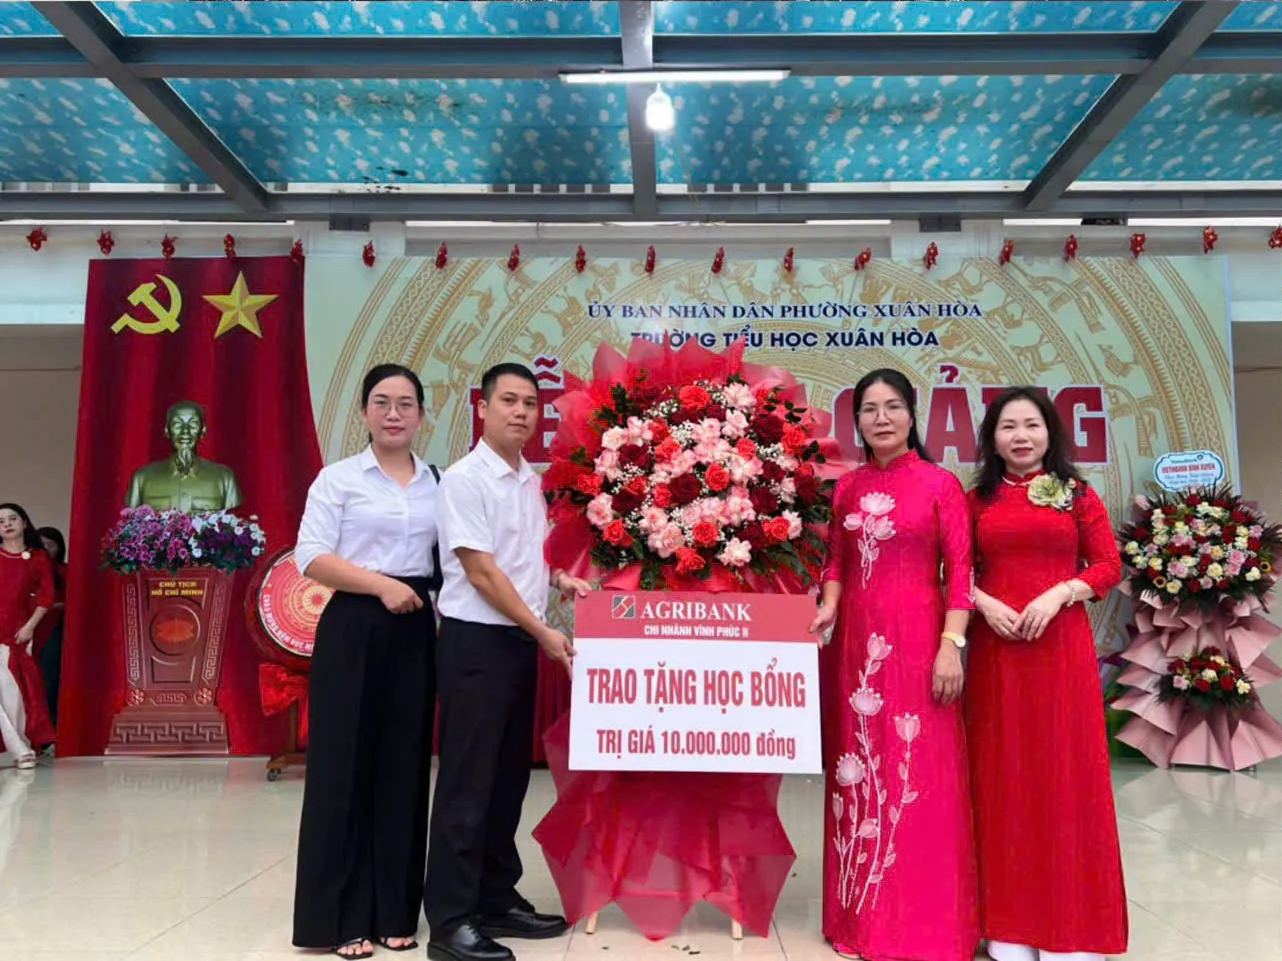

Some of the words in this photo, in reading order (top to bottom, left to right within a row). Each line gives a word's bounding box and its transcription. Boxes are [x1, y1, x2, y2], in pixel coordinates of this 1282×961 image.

[588, 300, 615, 319] ỦY
[622, 305, 662, 318] BAN
[669, 302, 726, 319] NHÂN
[732, 302, 775, 319] DÂN
[781, 300, 867, 319] PHƯỜNG
[874, 301, 932, 318] XUÂN
[937, 299, 981, 318] HÒA
[770, 331, 820, 351] HỌC
[826, 327, 884, 347] XUÂN
[890, 327, 938, 347] HÒA
[641, 601, 752, 621] AGRIBANK
[644, 625, 660, 635] CHI
[661, 624, 692, 636] NHÁNH
[694, 624, 715, 637] VĨNH
[716, 624, 740, 638] PHÚC
[587, 668, 637, 704] TRAO
[644, 661, 696, 713] TẶNG
[704, 670, 744, 714] HỌC
[751, 657, 806, 708] BỔNG
[597, 729, 622, 759] TRỊ
[628, 724, 655, 754] GIÁ
[661, 731, 750, 756] 10.000.000
[756, 728, 796, 760] đồng
